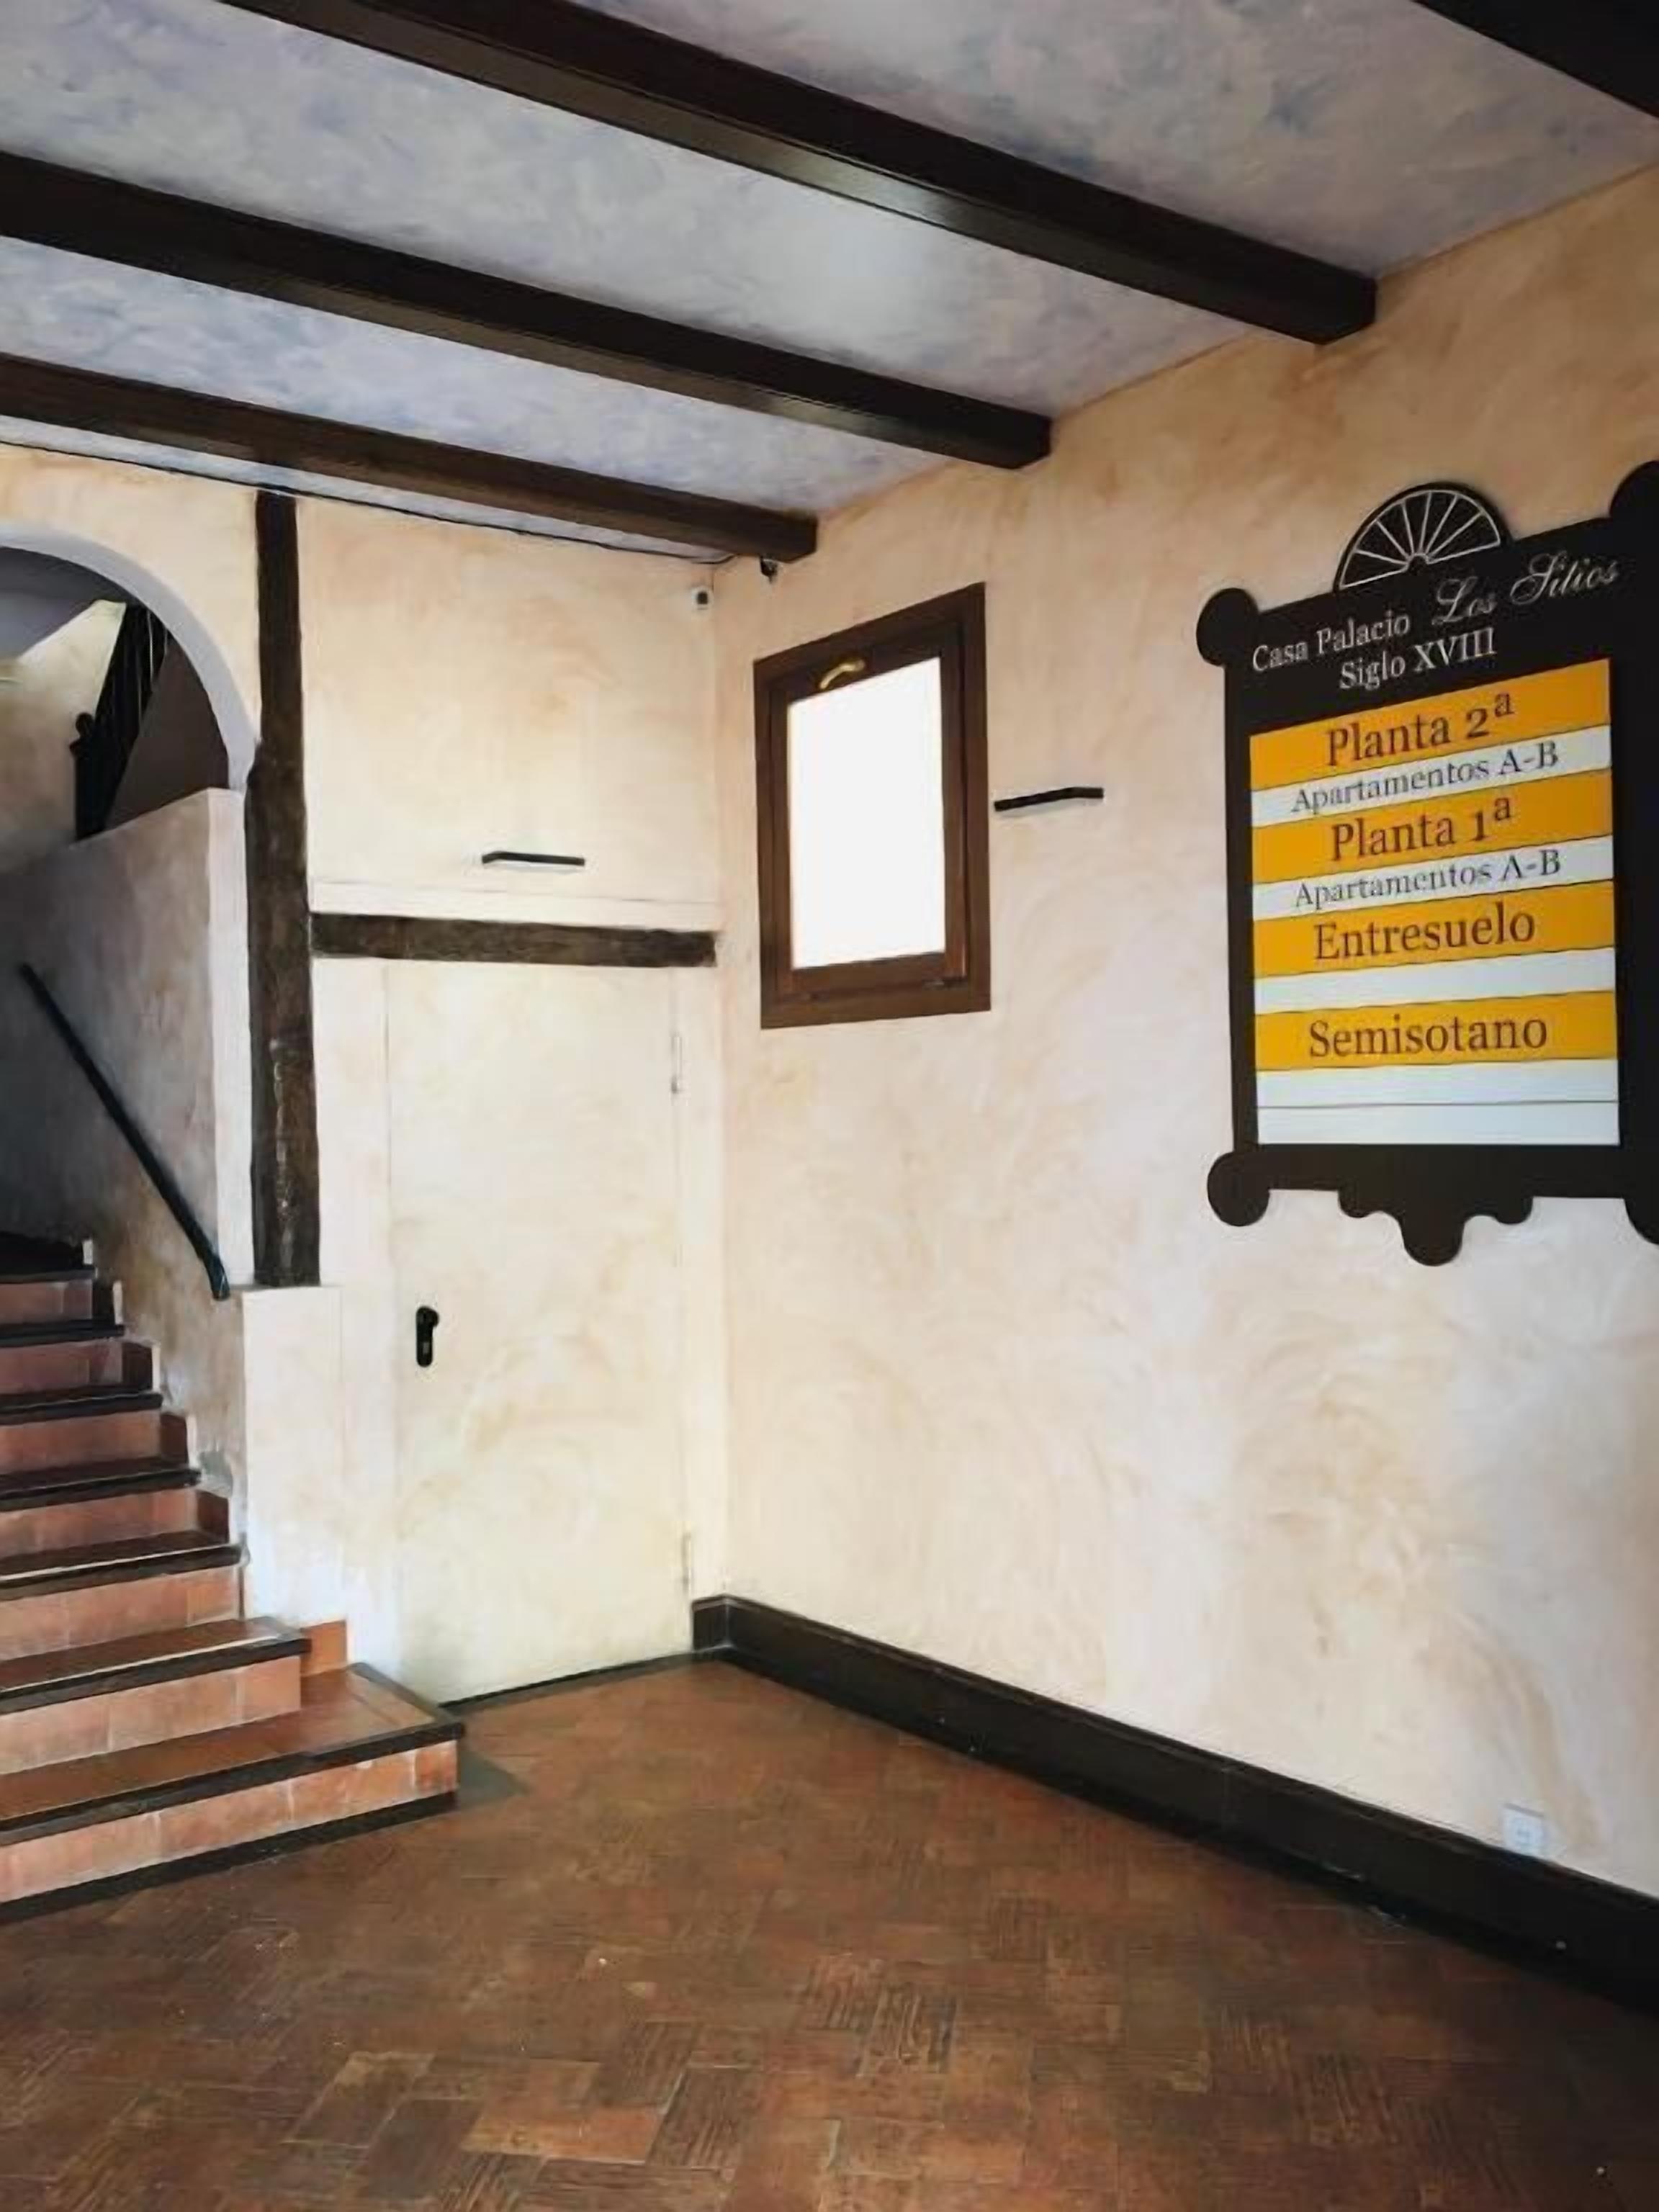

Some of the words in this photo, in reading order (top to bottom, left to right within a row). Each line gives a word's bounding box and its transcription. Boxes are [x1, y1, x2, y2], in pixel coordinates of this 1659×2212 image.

[1252, 641, 1308, 673] Casa
[1316, 610, 1411, 653] Palacio
[1431, 577, 1498, 625] Los
[1339, 654, 1406, 691] Siglo
[1415, 627, 1497, 671] XVIII
[1326, 714, 1450, 766] Planta
[1291, 756, 1490, 814] Apartamentos
[1498, 740, 1560, 775] A-B
[1331, 817, 1455, 861] Planta
[1296, 861, 1492, 910] Apartamentos
[1500, 848, 1562, 881] A-B
[1314, 902, 1535, 961] Entresuelo
[1309, 1014, 1547, 1057] Semisotano
